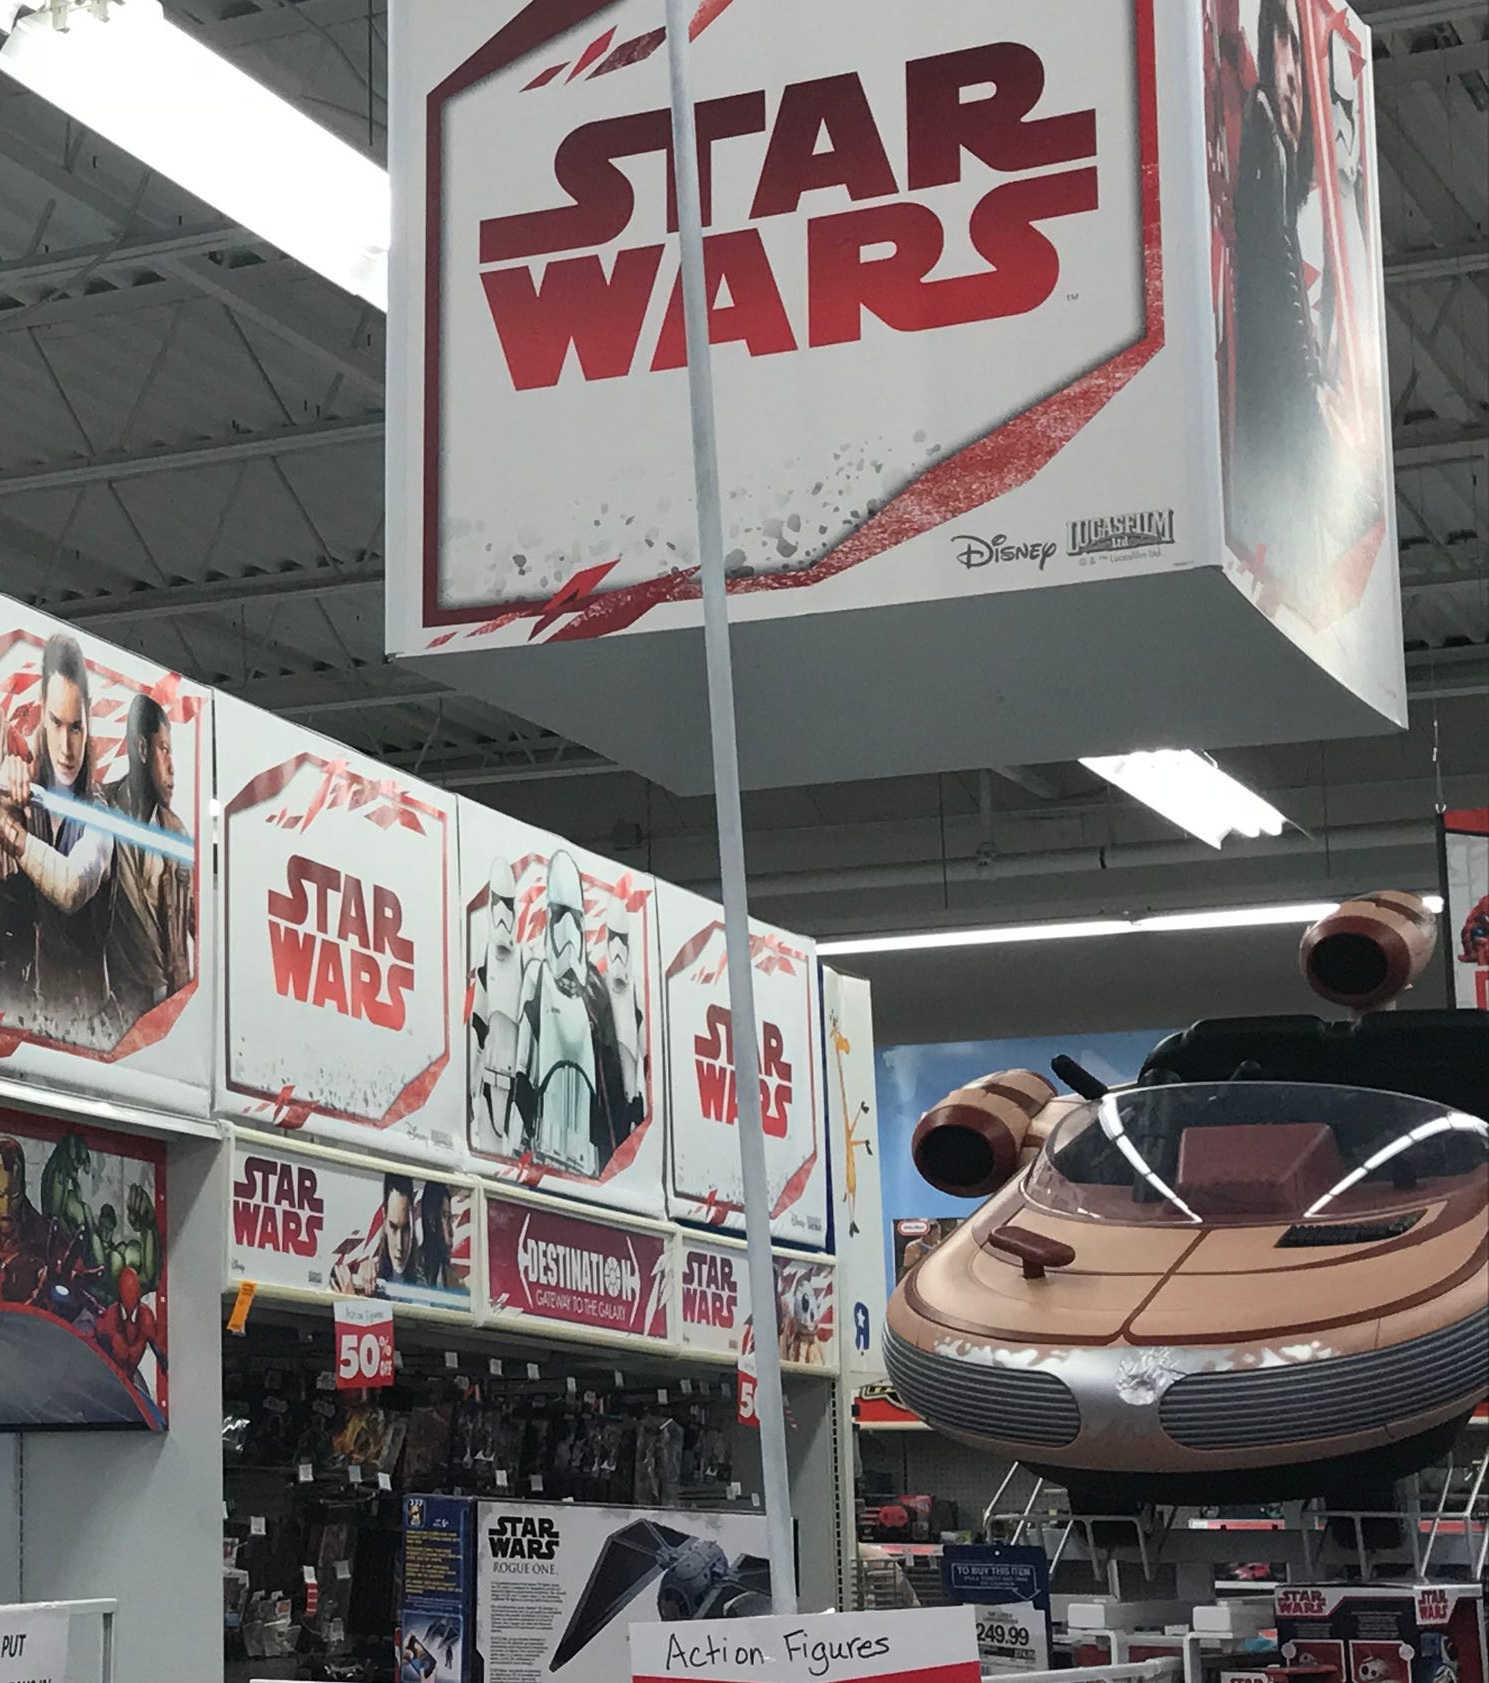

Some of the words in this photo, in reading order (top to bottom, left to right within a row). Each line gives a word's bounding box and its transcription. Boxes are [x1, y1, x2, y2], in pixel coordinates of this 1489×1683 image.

[479, 41, 1097, 263] STAR
[479, 165, 1099, 392] WARS
[951, 533, 1057, 570] Disney
[1066, 508, 1175, 556] LUCASFILM
[268, 854, 415, 965] STAR
[268, 919, 415, 1032] WARS
[233, 1156, 325, 1215] STAR
[233, 1199, 325, 1258] WARS
[526, 1237, 633, 1303] DESTINATION
[682, 1251, 738, 1294] STAR
[682, 1286, 738, 1329] WARS
[488, 1516, 560, 1539] STAR
[488, 1537, 560, 1560] WARS
[493, 1561, 531, 1575] ROGUE
[1278, 1599, 1326, 1615] WARS
[1280, 1589, 1326, 1606] STAR
[1418, 1589, 1448, 1606] STAR
[1418, 1603, 1448, 1621] WARS
[1, 1633, 27, 1658] PUT
[665, 1632, 766, 1671] Action
[783, 1629, 891, 1677] Figures
[976, 1622, 1030, 1646] 249.99
